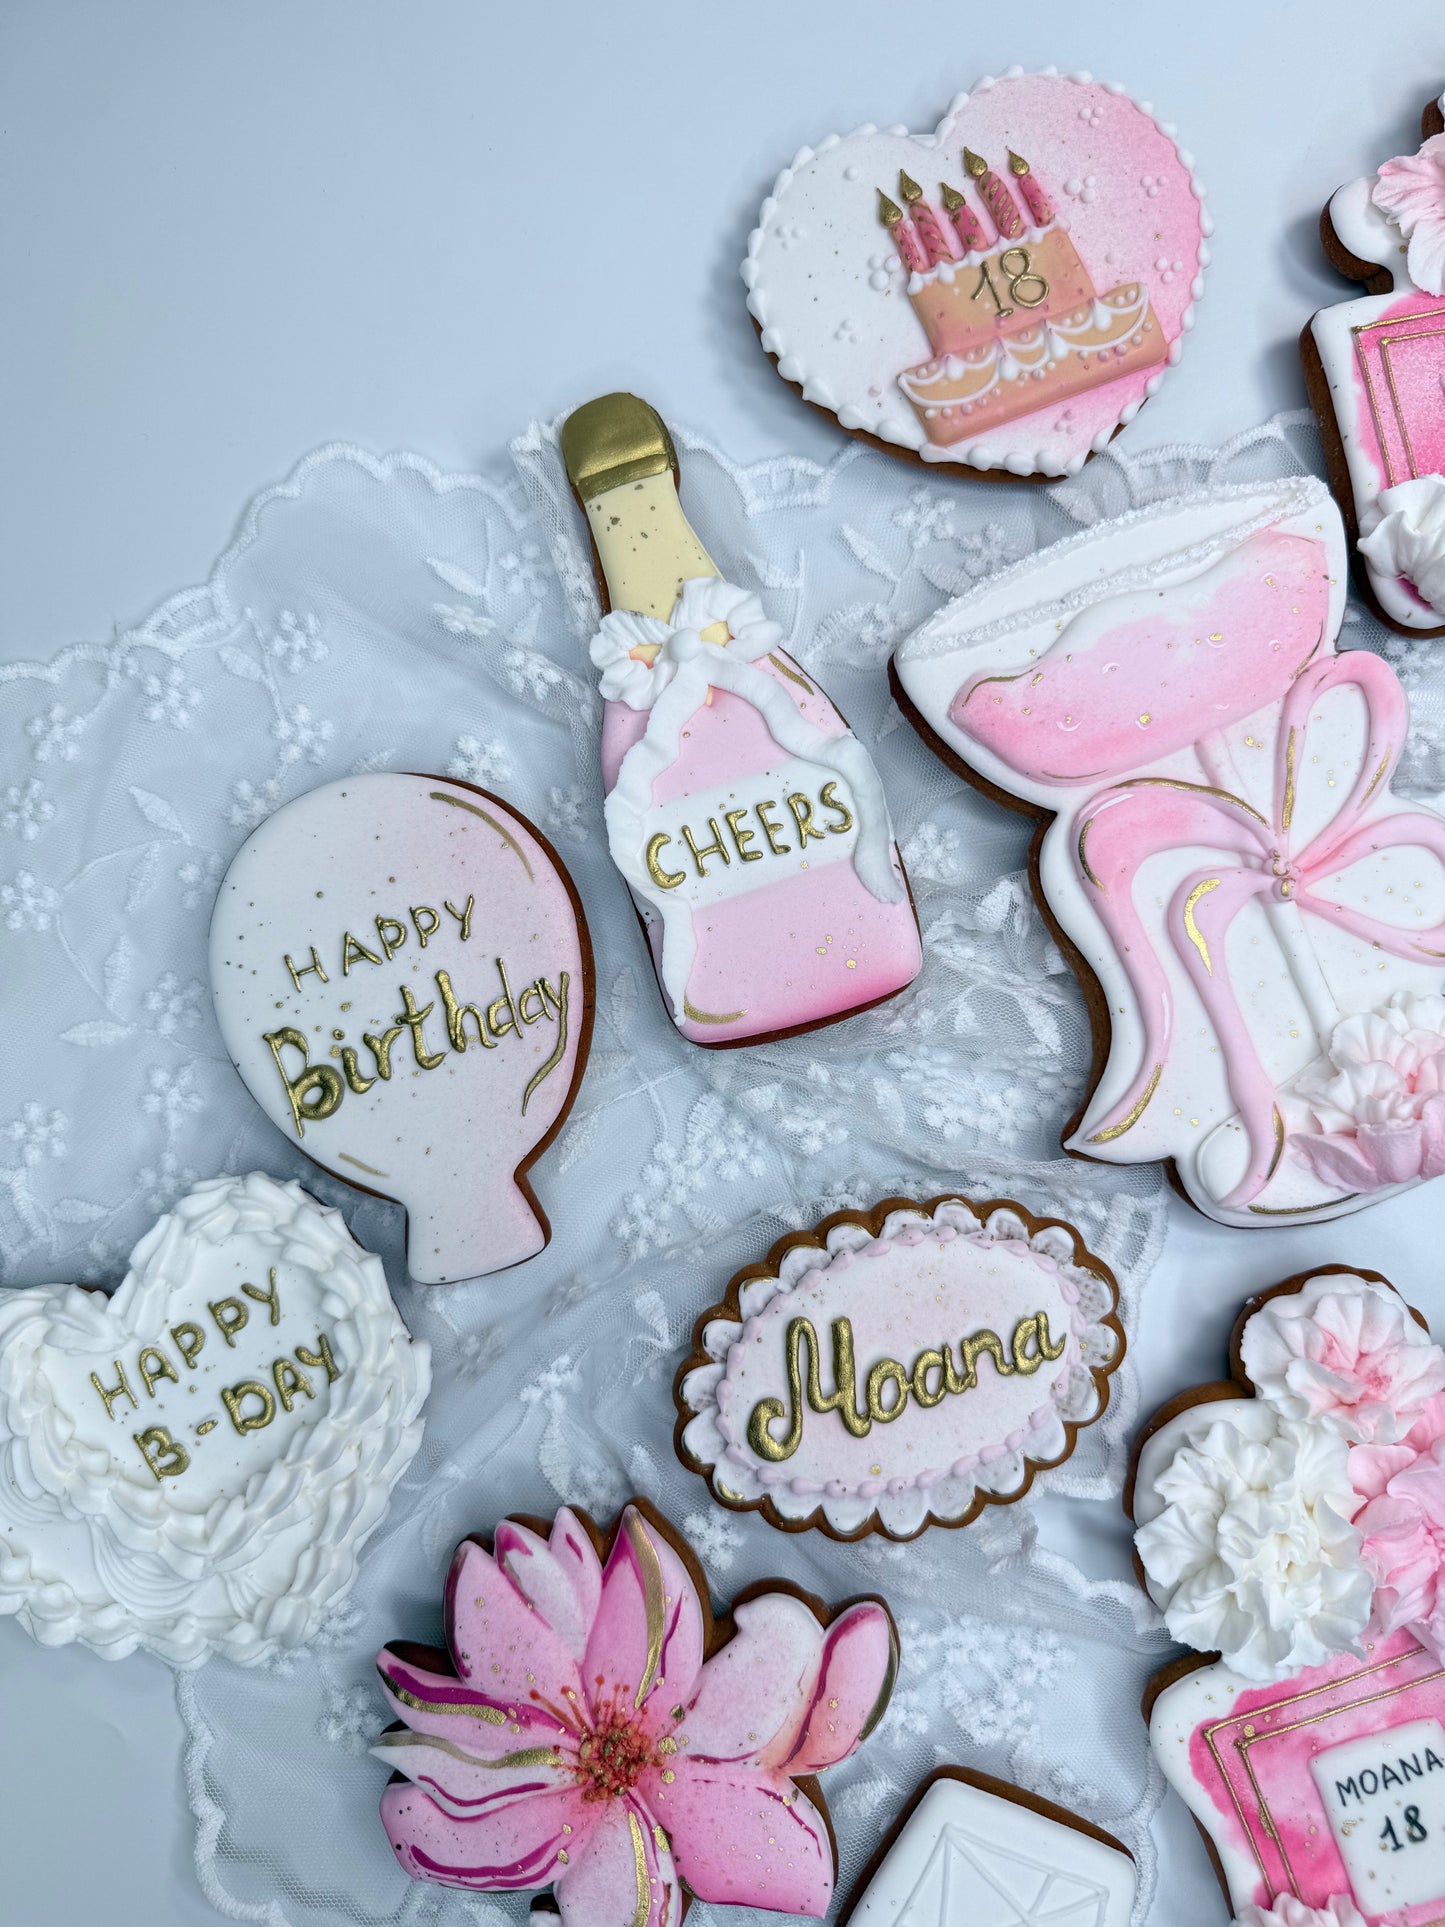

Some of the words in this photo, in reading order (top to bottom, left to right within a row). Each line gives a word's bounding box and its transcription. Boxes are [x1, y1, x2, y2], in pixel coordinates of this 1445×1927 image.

[971, 247, 1049, 318] 18
[646, 782, 853, 889] CHEERS
[284, 894, 474, 992] HAPPY
[262, 957, 570, 1138] Birthday
[90, 1266, 280, 1420] HAPPY
[747, 1310, 1067, 1462] Moana
[1335, 1747, 1444, 1807] MOANA
[1380, 1804, 1428, 1852] 18
